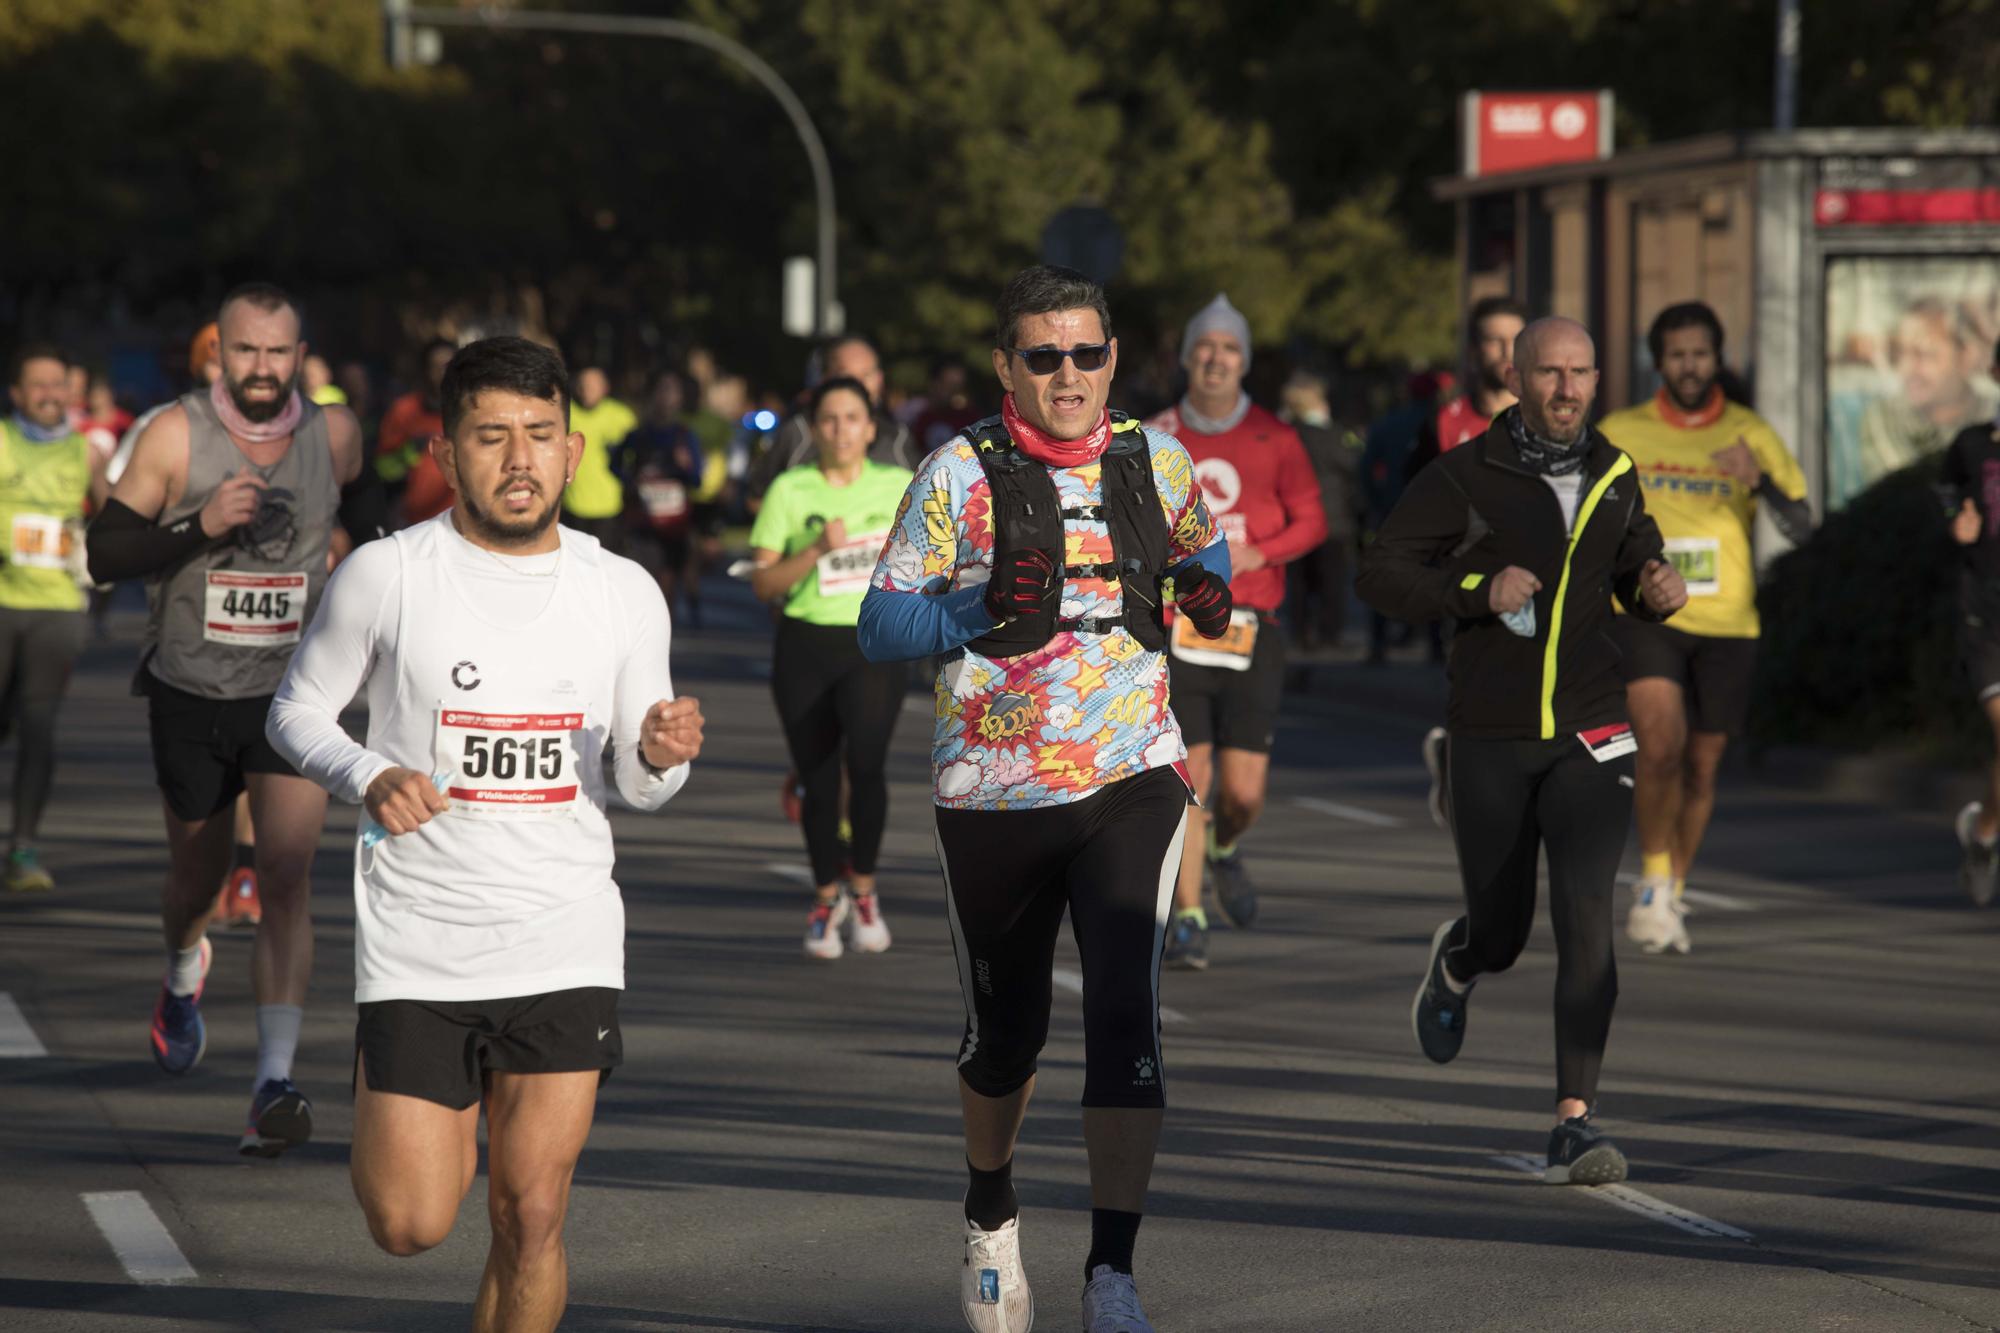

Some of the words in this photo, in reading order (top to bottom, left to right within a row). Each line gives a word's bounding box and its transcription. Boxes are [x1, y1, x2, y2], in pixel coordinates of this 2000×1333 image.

[222, 589, 290, 619] 4445
[984, 702, 1044, 743] BOOM
[462, 735, 562, 780] 5615
